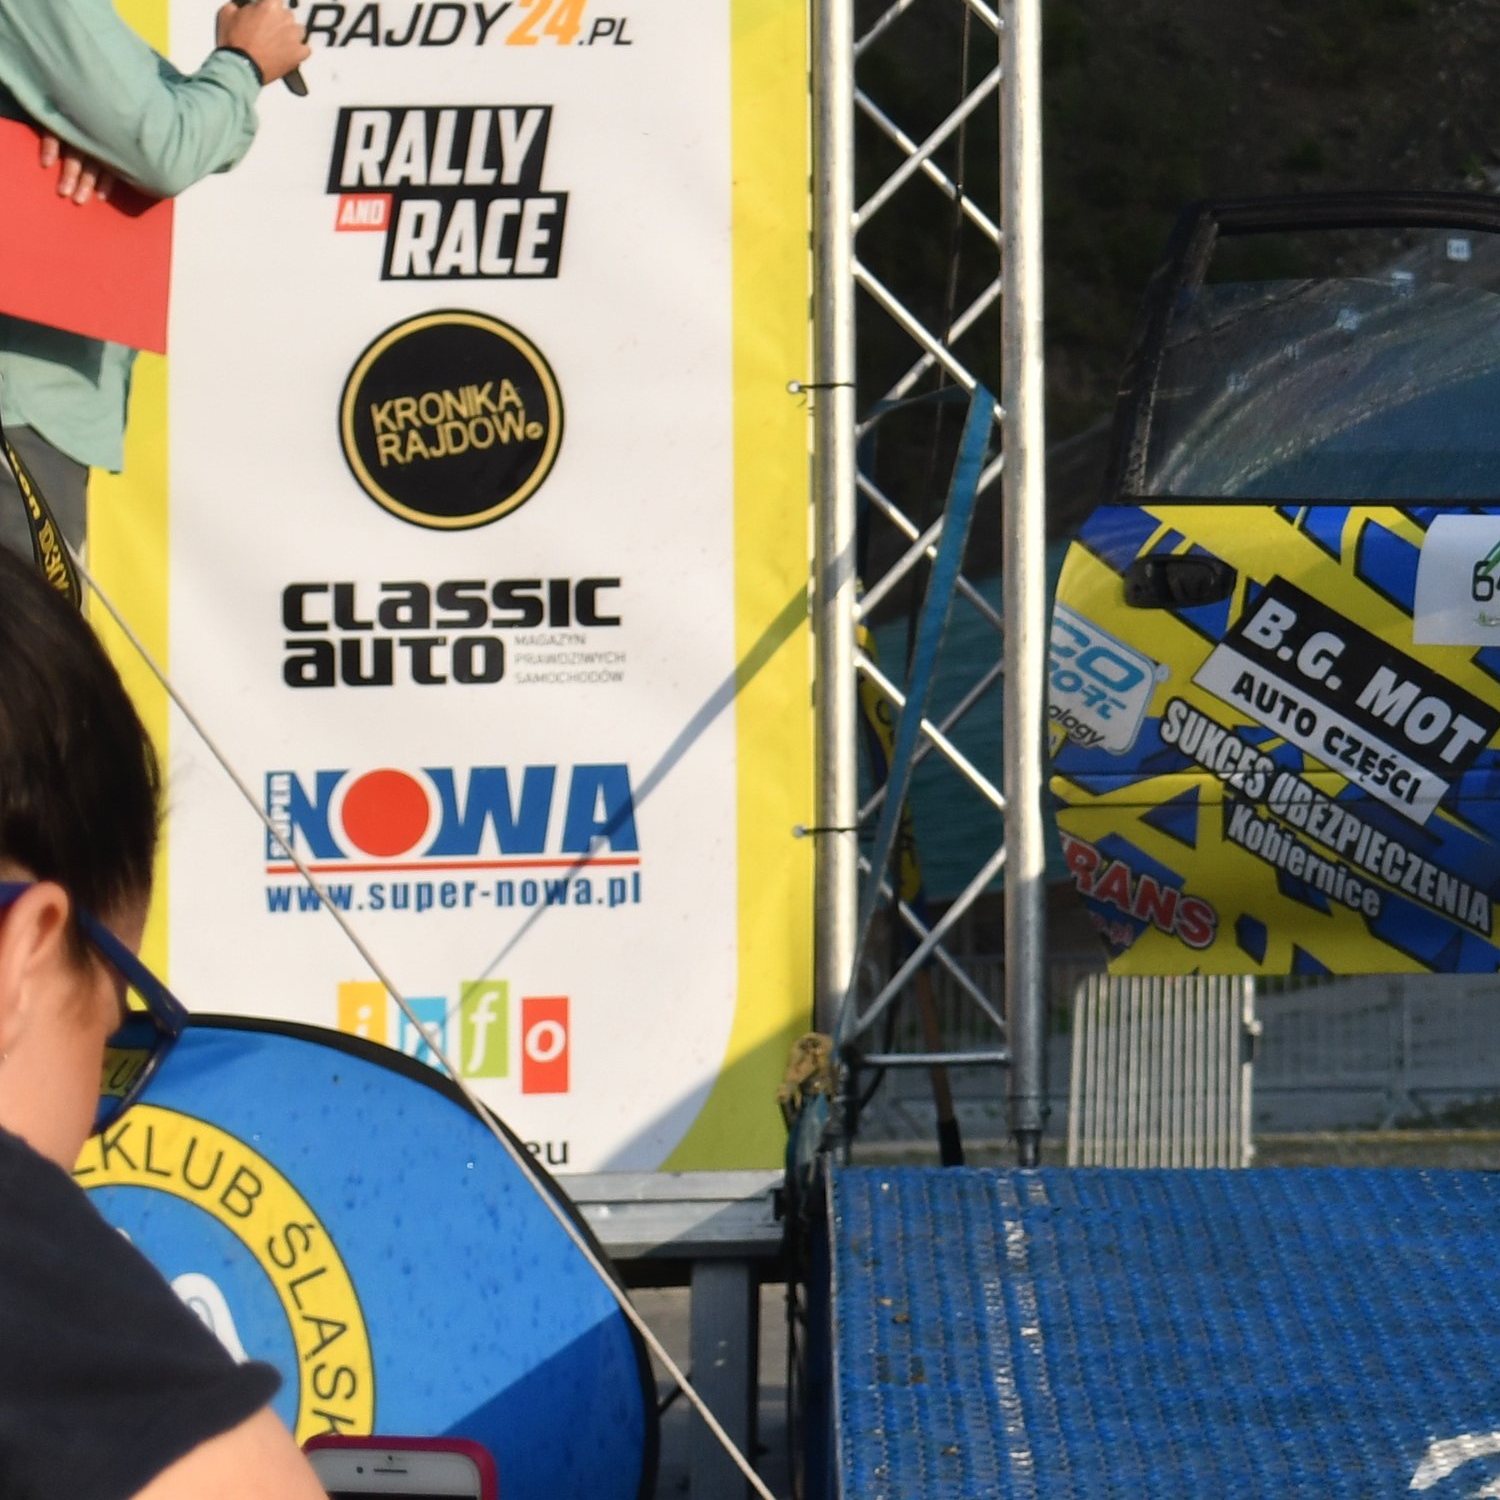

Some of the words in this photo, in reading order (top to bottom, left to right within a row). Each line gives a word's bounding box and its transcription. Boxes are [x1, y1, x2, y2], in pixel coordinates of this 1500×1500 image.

[340, 108, 546, 187] RALLY
[339, 198, 386, 227] AND
[389, 197, 558, 276] RACE
[370, 378, 524, 436] KRONIKA
[1242, 596, 1346, 691] B.G.
[1355, 665, 1487, 764] MOT
[1232, 670, 1319, 738] AUTO
[1321, 726, 1422, 806] CZĘŚCI
[265, 763, 640, 860] NOWA
[1161, 702, 1273, 799] SUKCES
[1268, 770, 1494, 934] UBEZPIECZENIA
[265, 872, 643, 913] www.super-nowa.pl
[1228, 806, 1383, 919] Kobiernice
